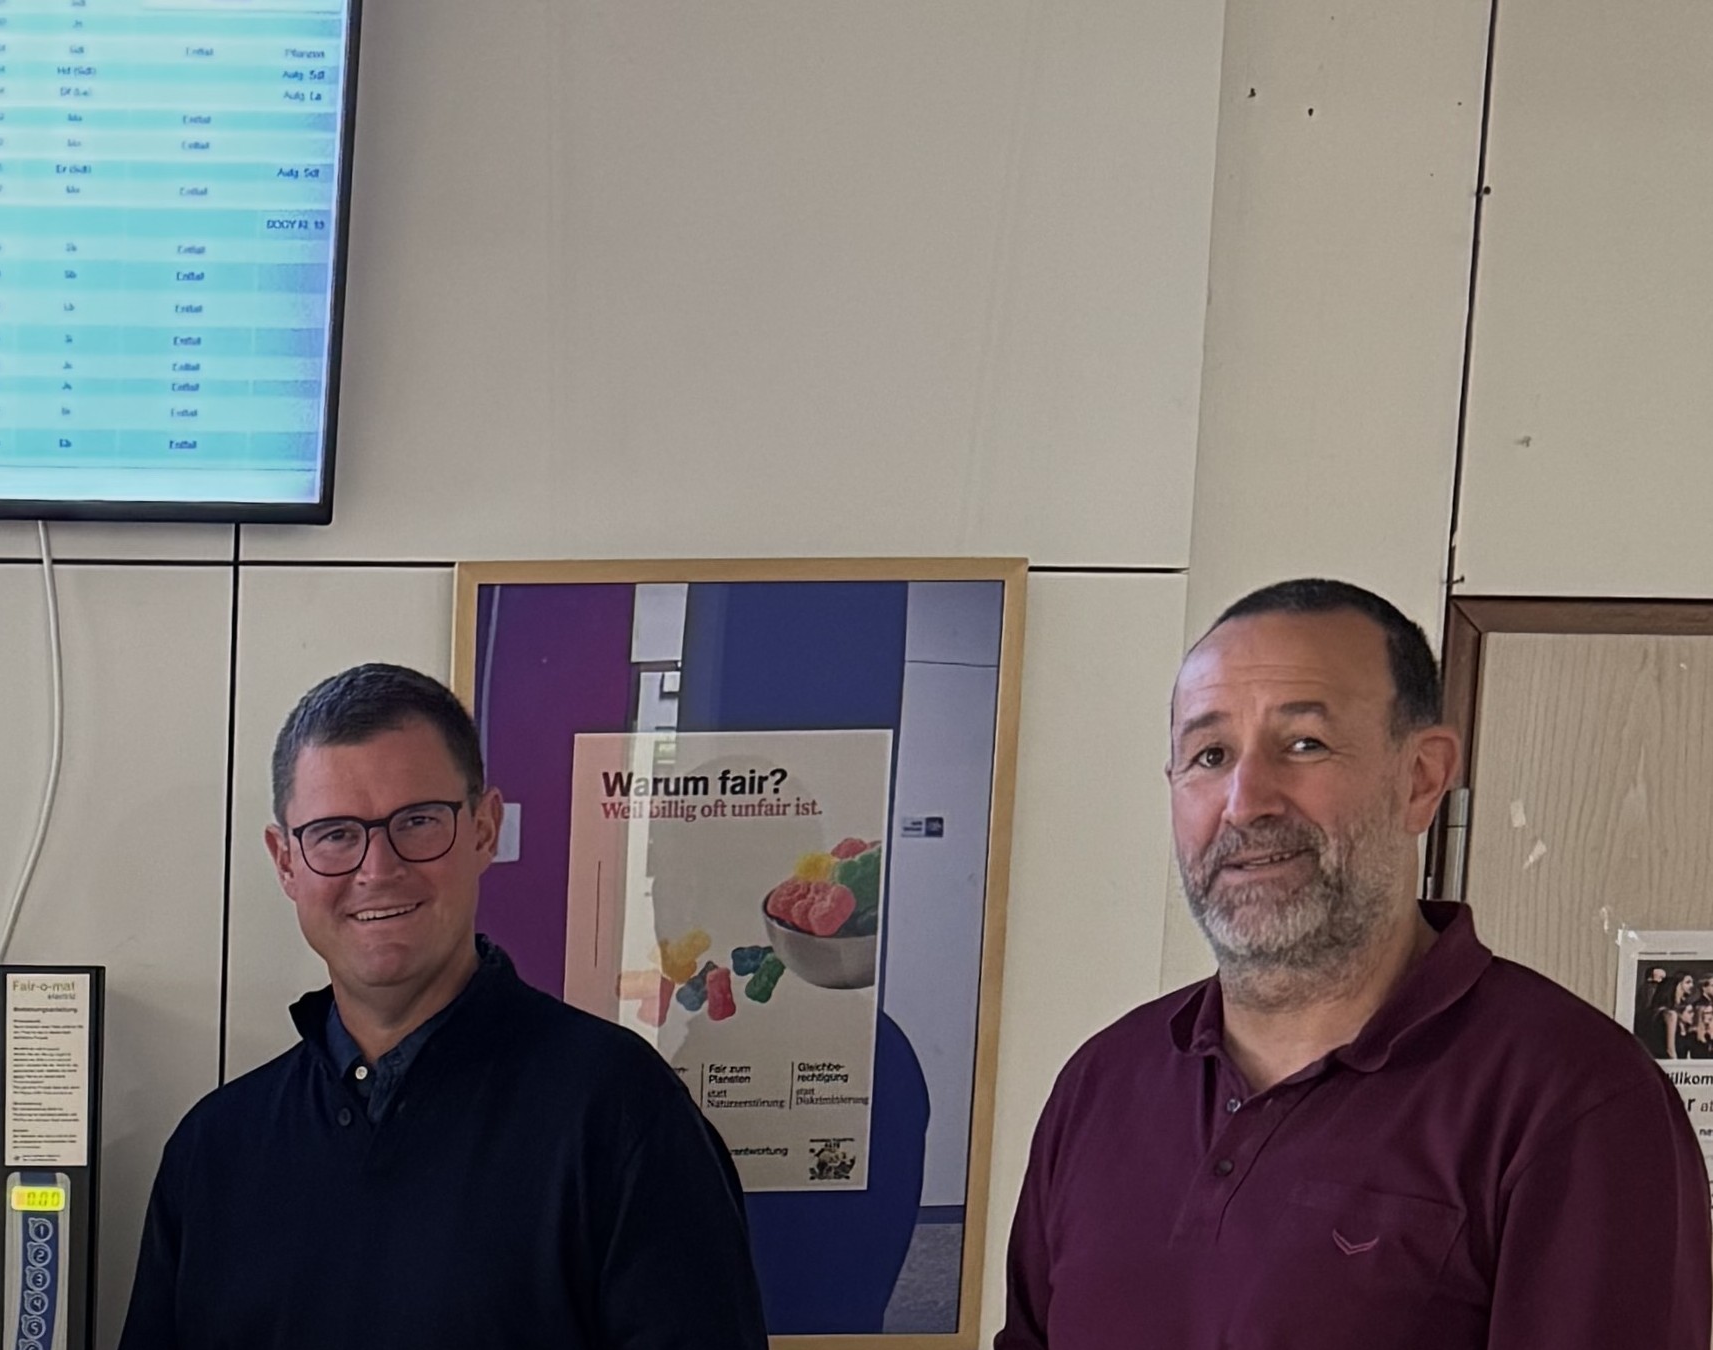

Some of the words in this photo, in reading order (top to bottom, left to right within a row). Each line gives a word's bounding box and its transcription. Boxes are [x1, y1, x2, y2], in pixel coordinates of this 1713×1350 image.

[602, 771, 709, 797] Warum
[718, 768, 788, 795] fair?
[602, 801, 644, 819] Weil
[648, 800, 696, 822] billig
[701, 799, 727, 818] oft
[732, 799, 790, 817] unfair
[795, 797, 823, 816] ist.
